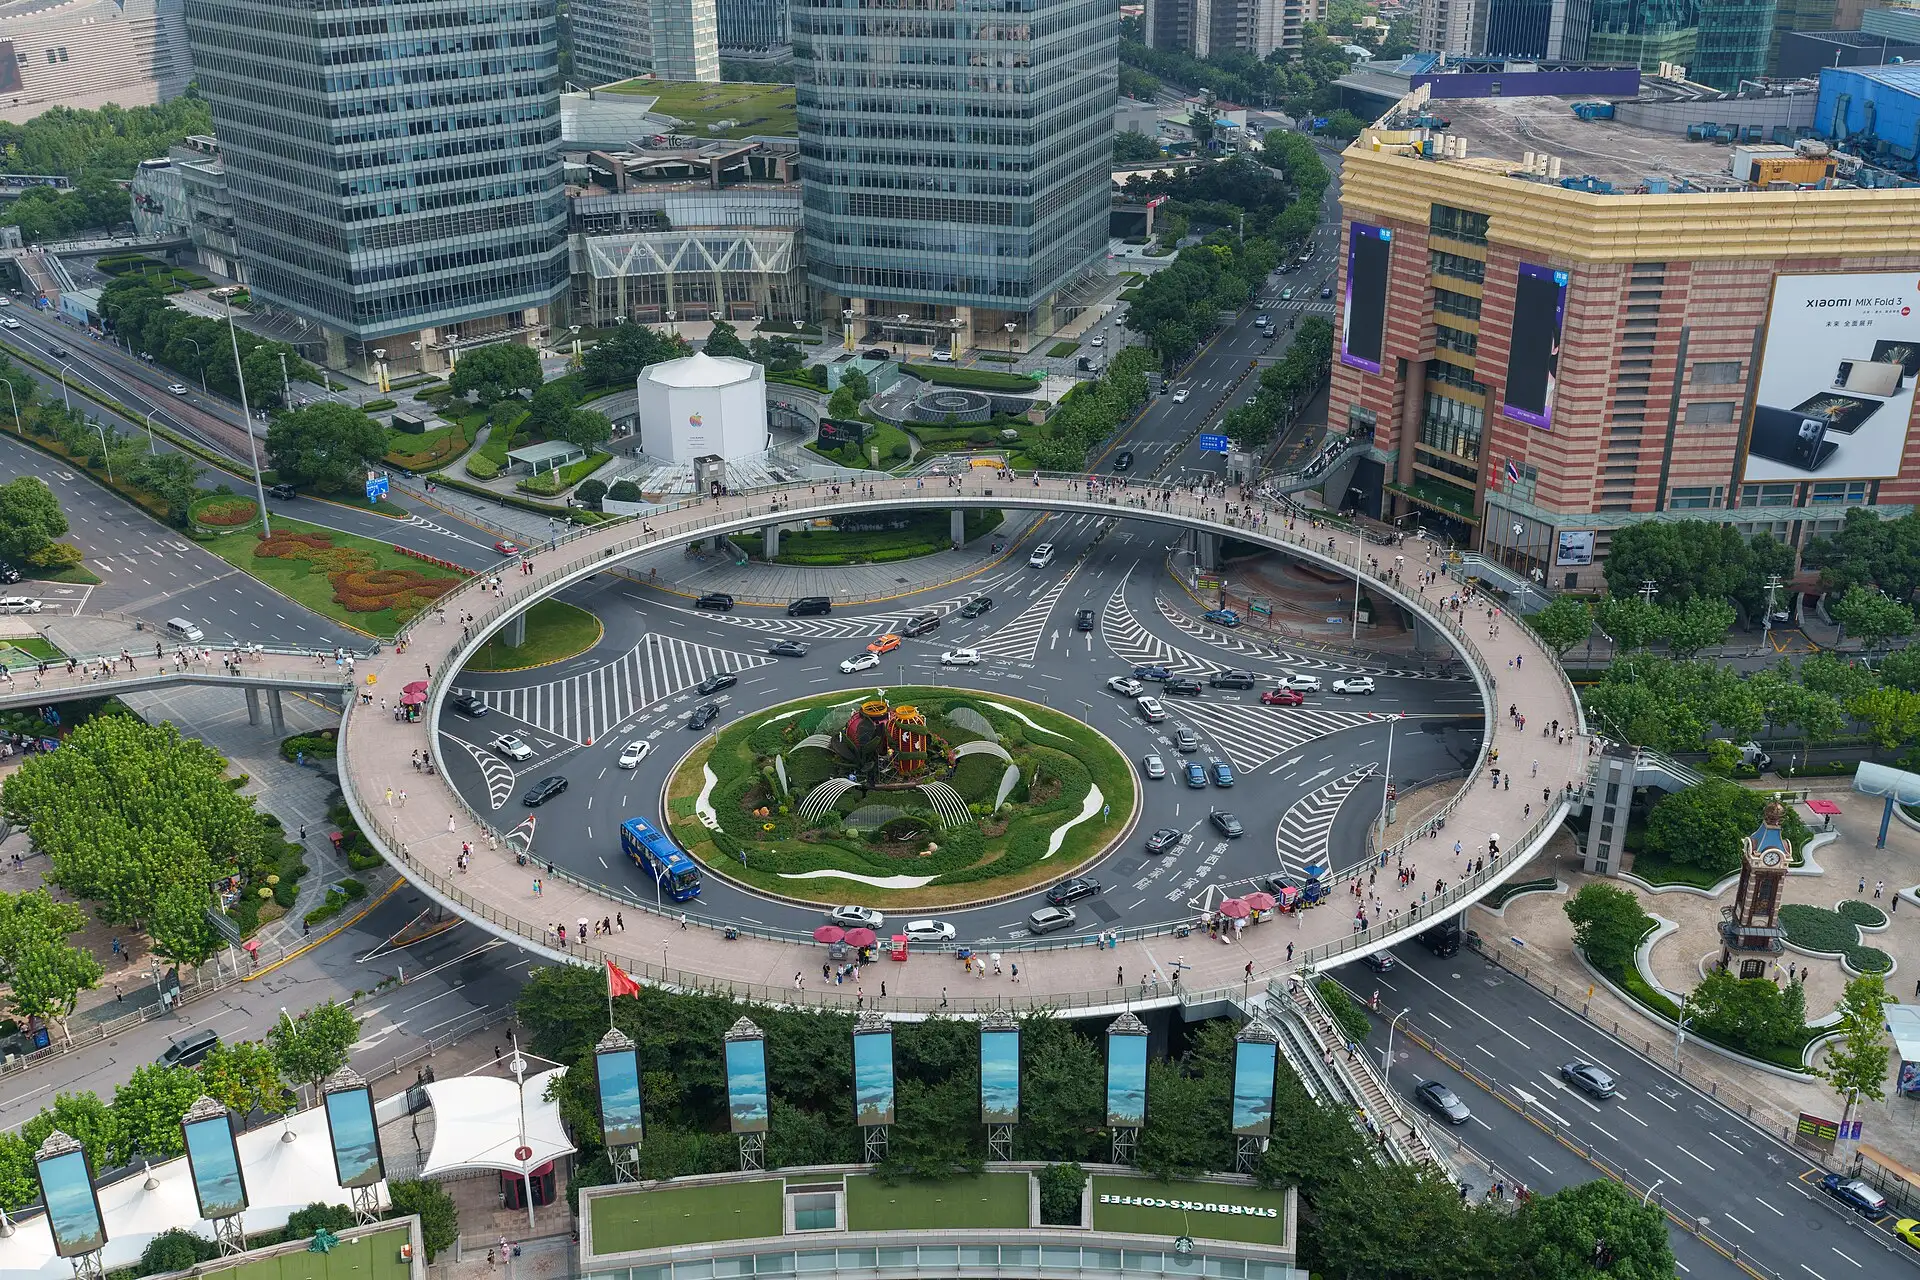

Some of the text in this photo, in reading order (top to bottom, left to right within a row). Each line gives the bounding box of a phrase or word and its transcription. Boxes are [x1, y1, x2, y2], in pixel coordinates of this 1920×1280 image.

[1806, 297, 1903, 308] xiaomi MIX Fold 3
[1100, 1194, 1278, 1218] STARBUCKS COFFEE
